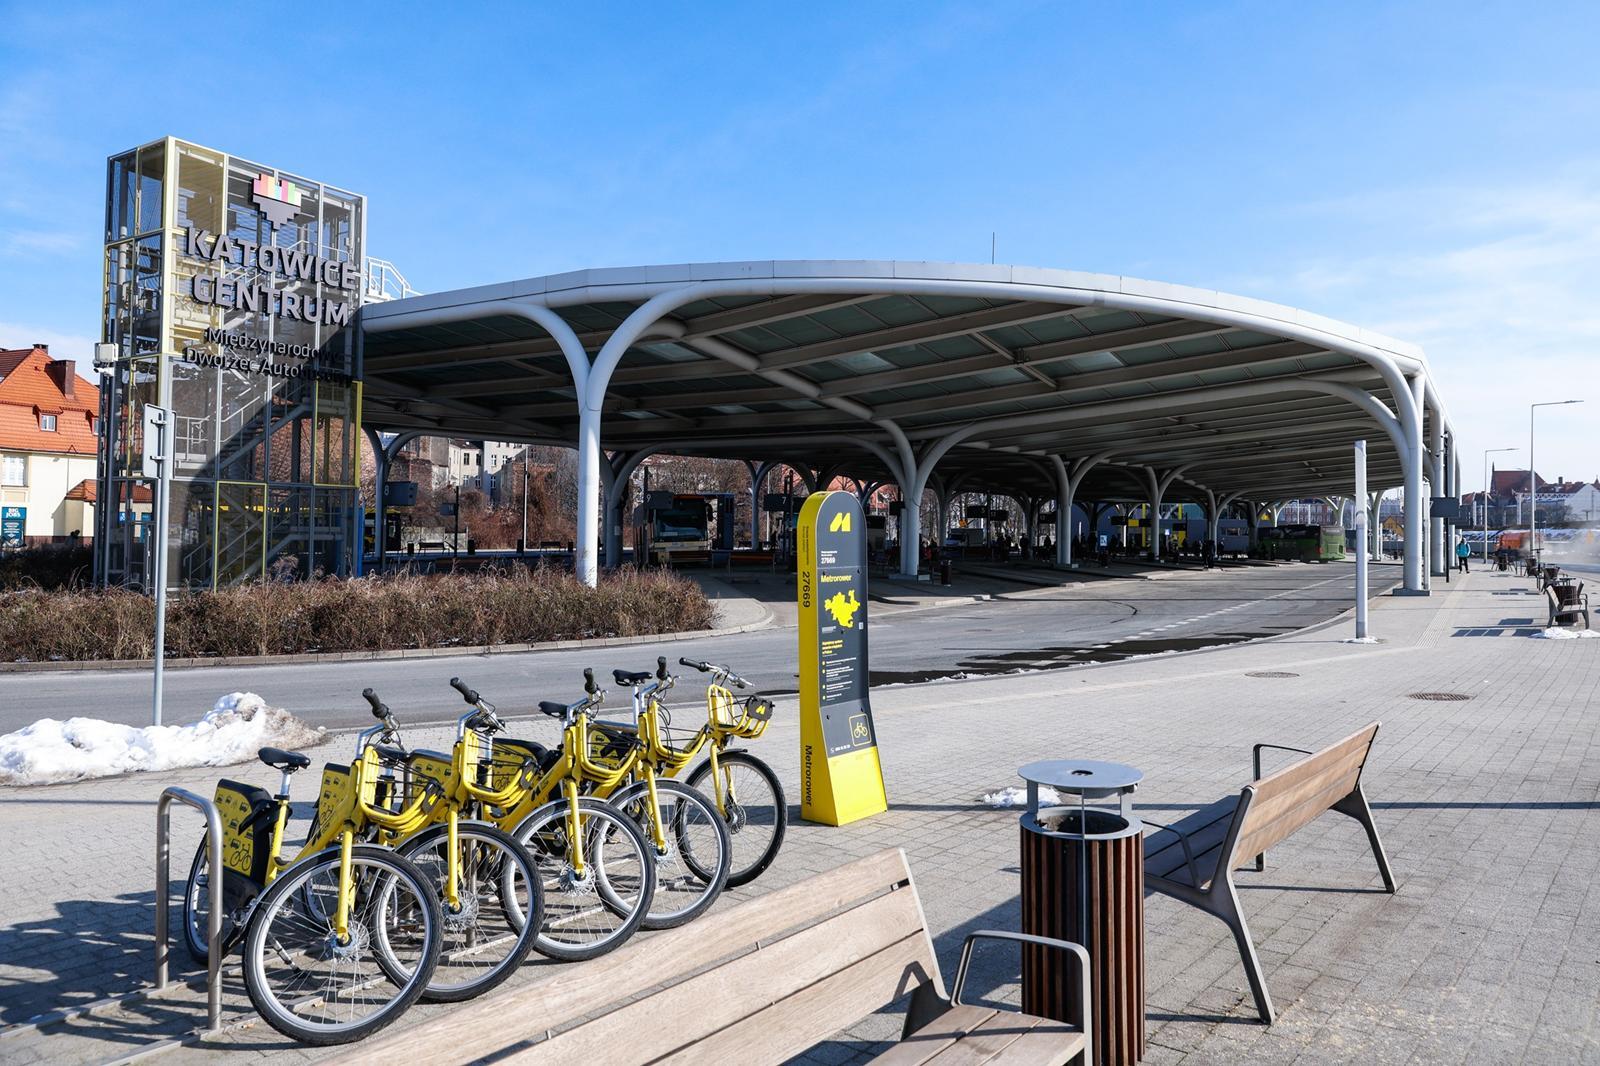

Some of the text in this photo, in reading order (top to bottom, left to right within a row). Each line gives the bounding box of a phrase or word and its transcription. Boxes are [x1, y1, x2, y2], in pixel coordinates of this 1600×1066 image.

[187, 226, 357, 290] KATOWICE
[192, 273, 349, 326] CENTRUM
[186, 347, 256, 373] Dworzec
[802, 571, 811, 608] 27669
[821, 575, 852, 583] Metrorower
[805, 745, 813, 806] Metrorower
